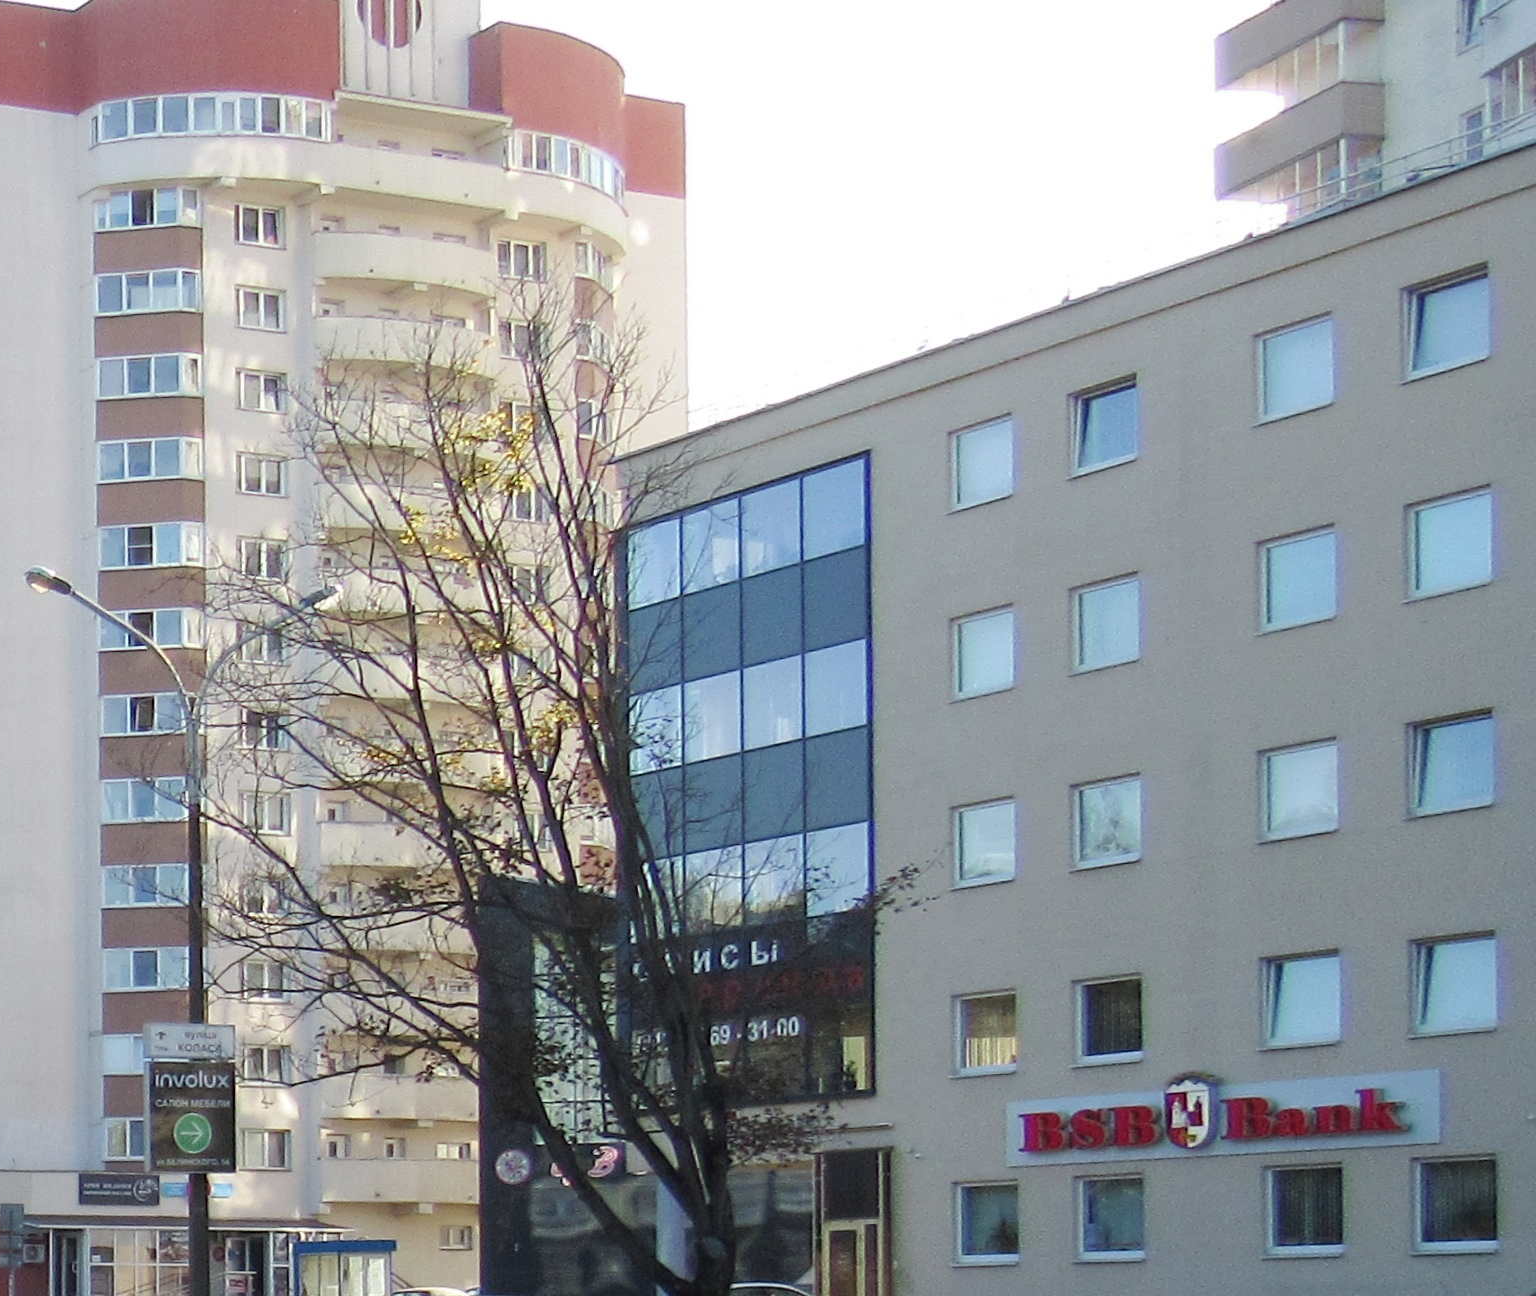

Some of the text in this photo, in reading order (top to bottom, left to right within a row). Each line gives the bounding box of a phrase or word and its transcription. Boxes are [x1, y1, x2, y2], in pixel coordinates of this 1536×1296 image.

[154, 1069, 231, 1089] involux
[155, 1099, 189, 1108] САЛОН
[1019, 1087, 1406, 1154] BSB Bank
